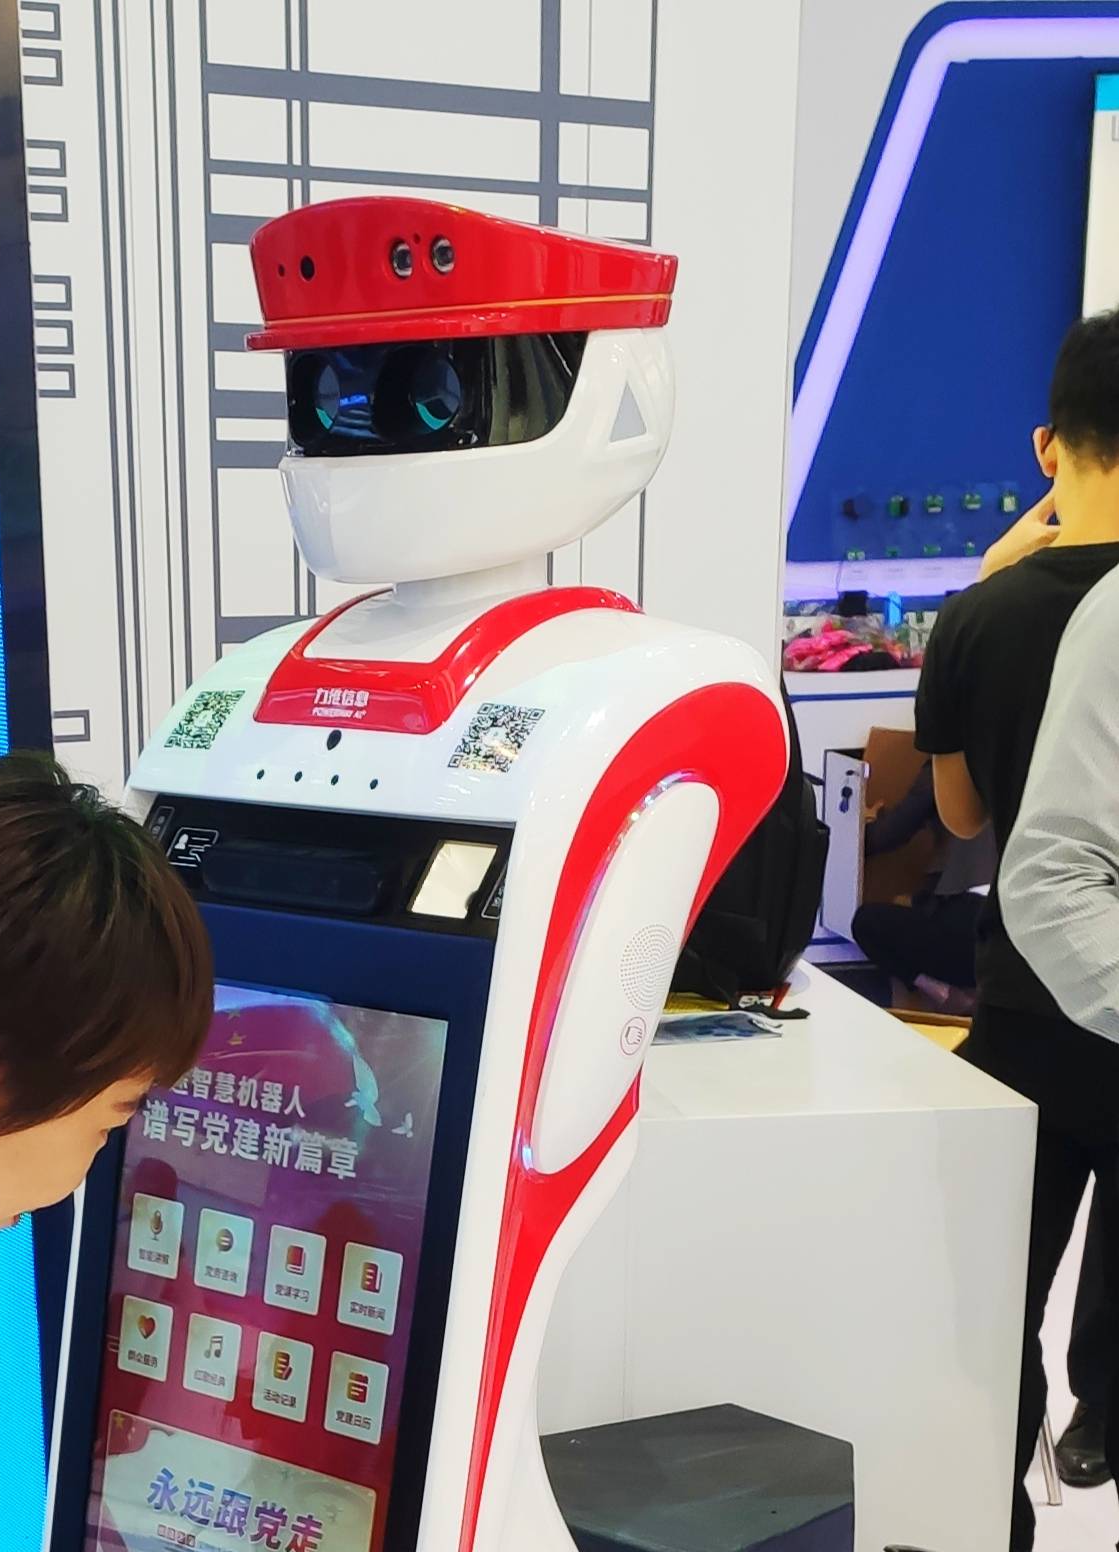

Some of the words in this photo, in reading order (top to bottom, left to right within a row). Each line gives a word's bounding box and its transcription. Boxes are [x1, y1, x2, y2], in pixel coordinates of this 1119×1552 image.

[142, 1099, 359, 1180] 谱写党建新篇章
